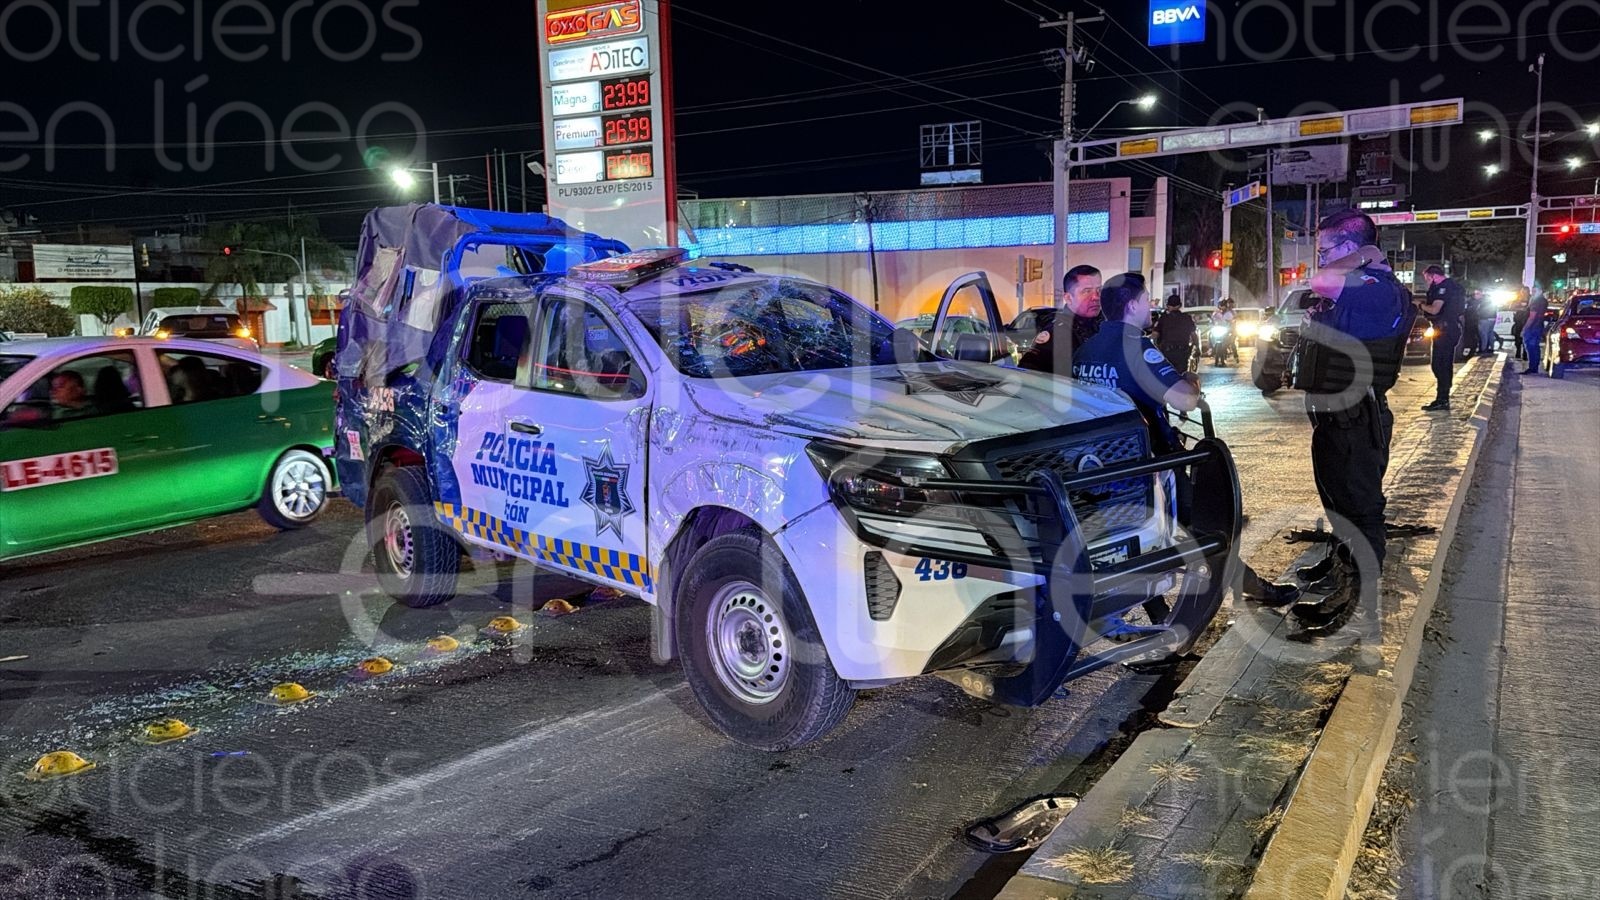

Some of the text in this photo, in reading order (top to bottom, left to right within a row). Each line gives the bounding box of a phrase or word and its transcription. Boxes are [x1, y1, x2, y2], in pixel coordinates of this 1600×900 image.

[550, 5, 639, 35] OXXO GAS
[1153, 5, 1201, 25] BBVA
[554, 80, 649, 109] Magna 23.99
[556, 117, 650, 145] Premium 26.99
[558, 182, 653, 198] PL/9302/EXP/ES/2015
[476, 432, 557, 476] POICÍA
[4, 450, 113, 488] LE-4615
[915, 556, 968, 582] 436
